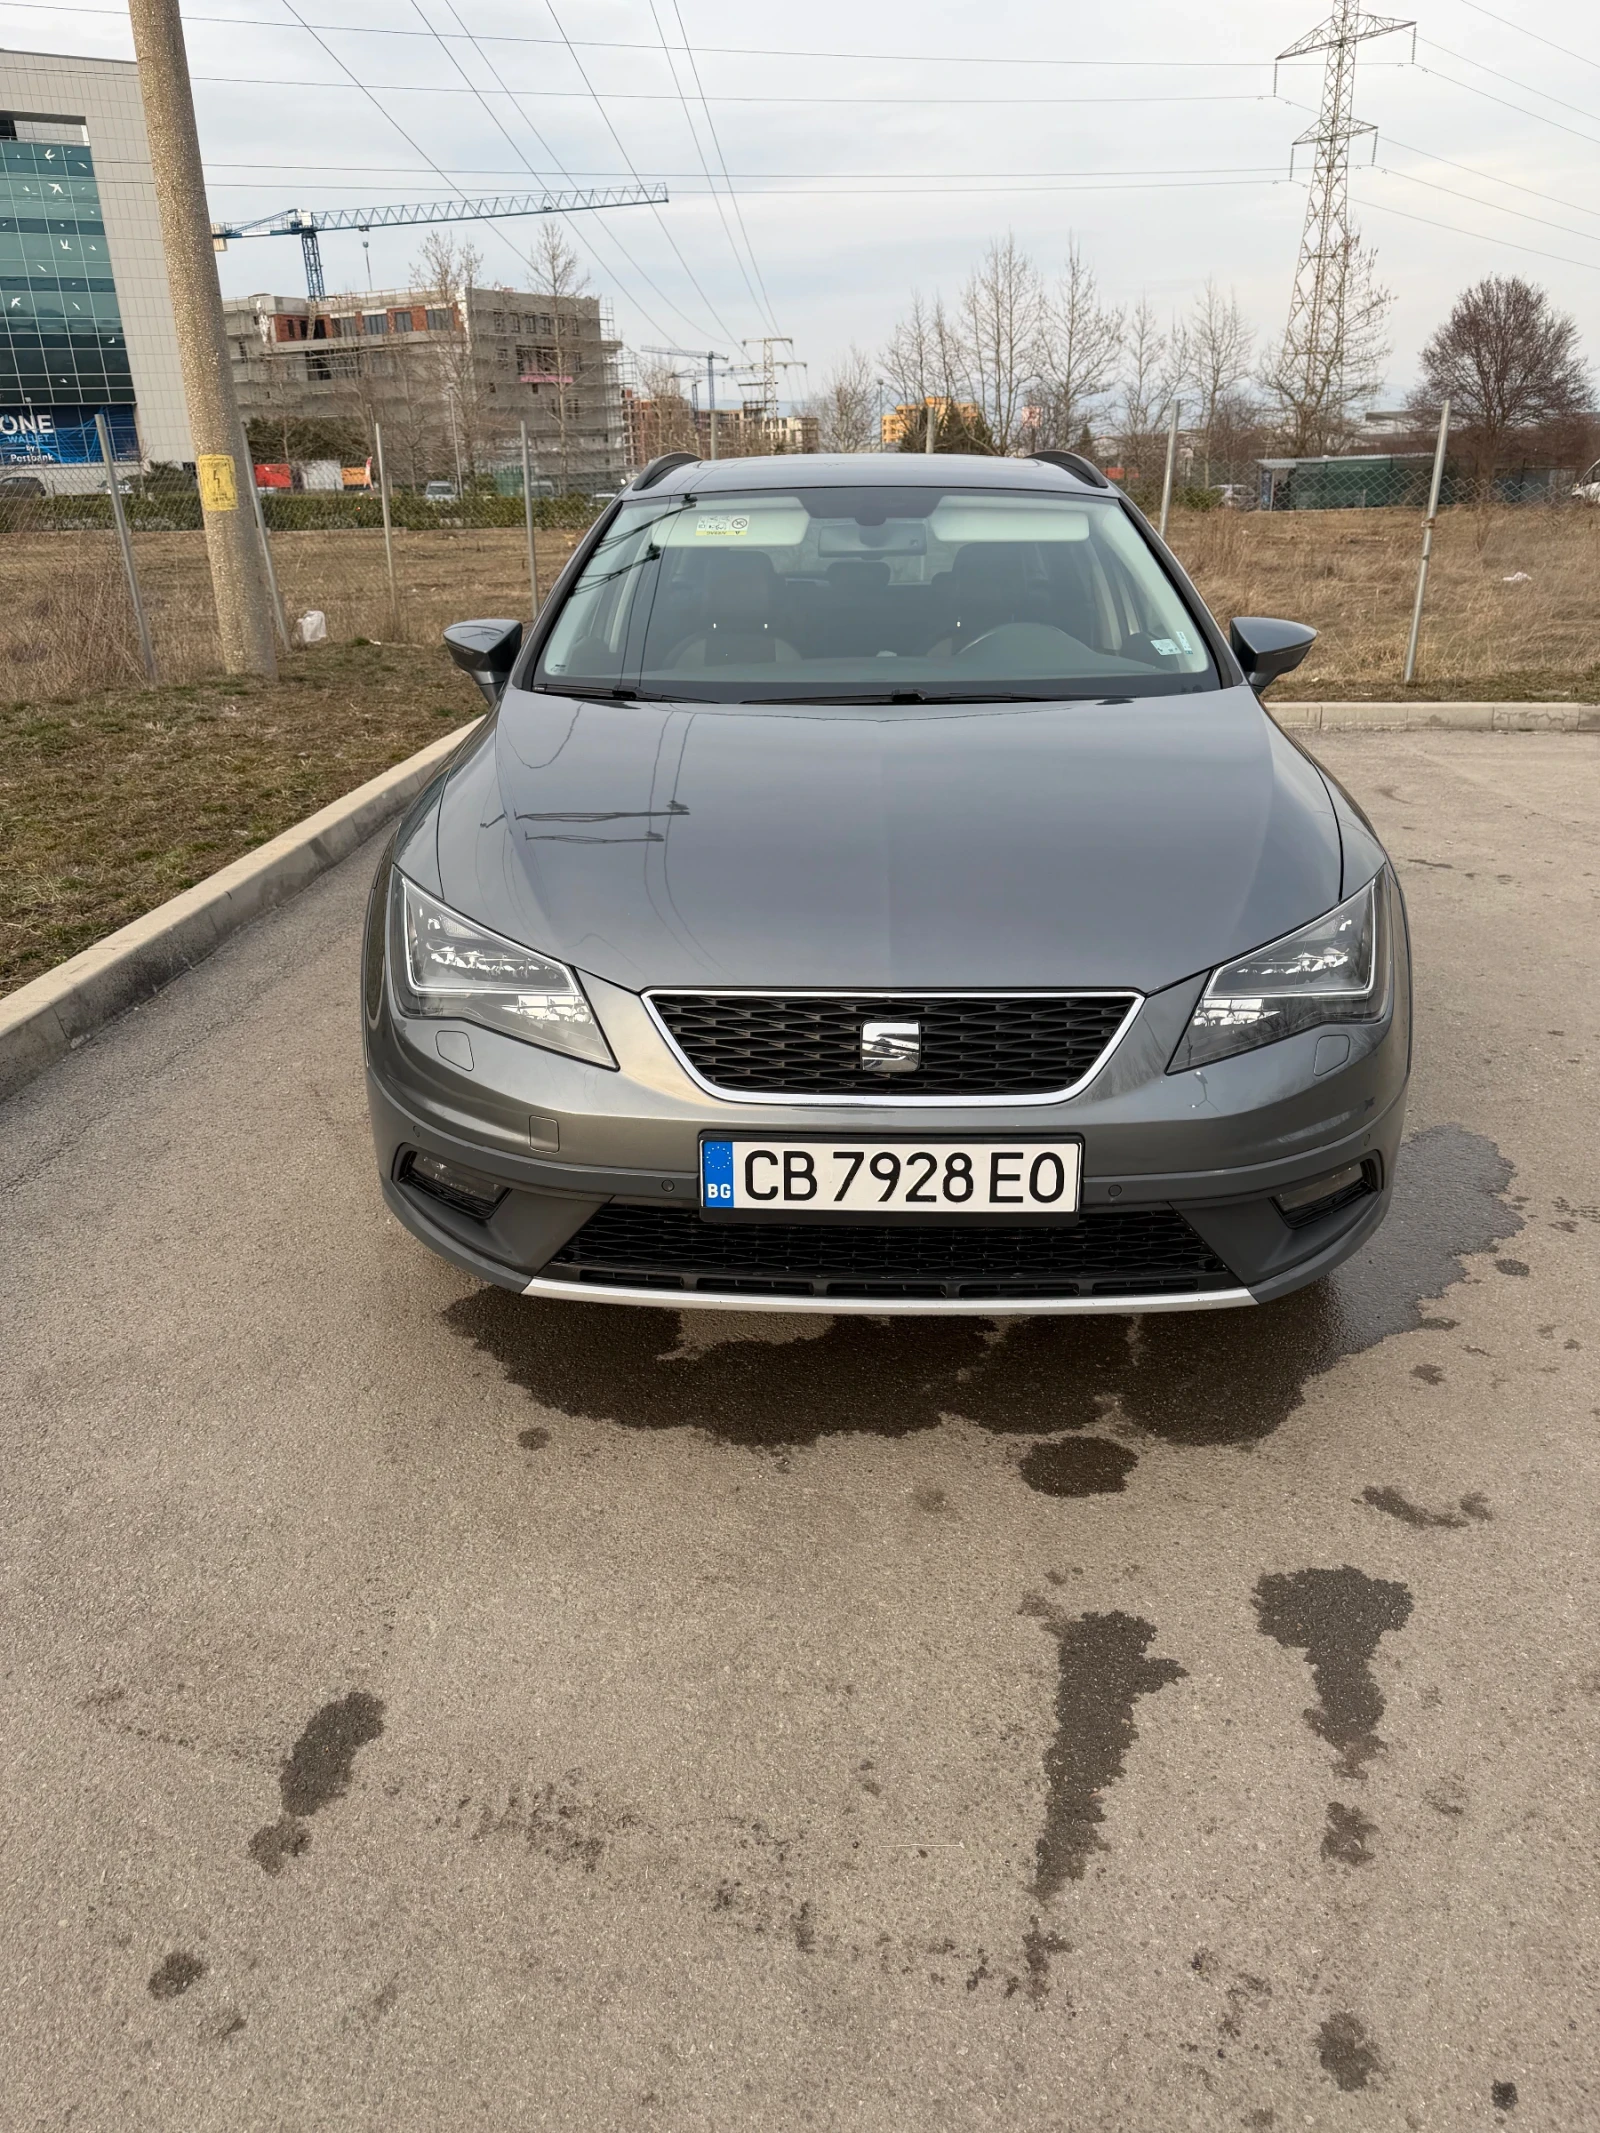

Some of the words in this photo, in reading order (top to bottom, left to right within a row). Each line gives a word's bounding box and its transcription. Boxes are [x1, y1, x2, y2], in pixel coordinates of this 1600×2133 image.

[0, 414, 54, 435] ONE
[7, 434, 50, 443] WALLET
[744, 1150, 818, 1201] CB
[833, 1151, 974, 1203] 7928
[707, 1183, 731, 1199] BG
